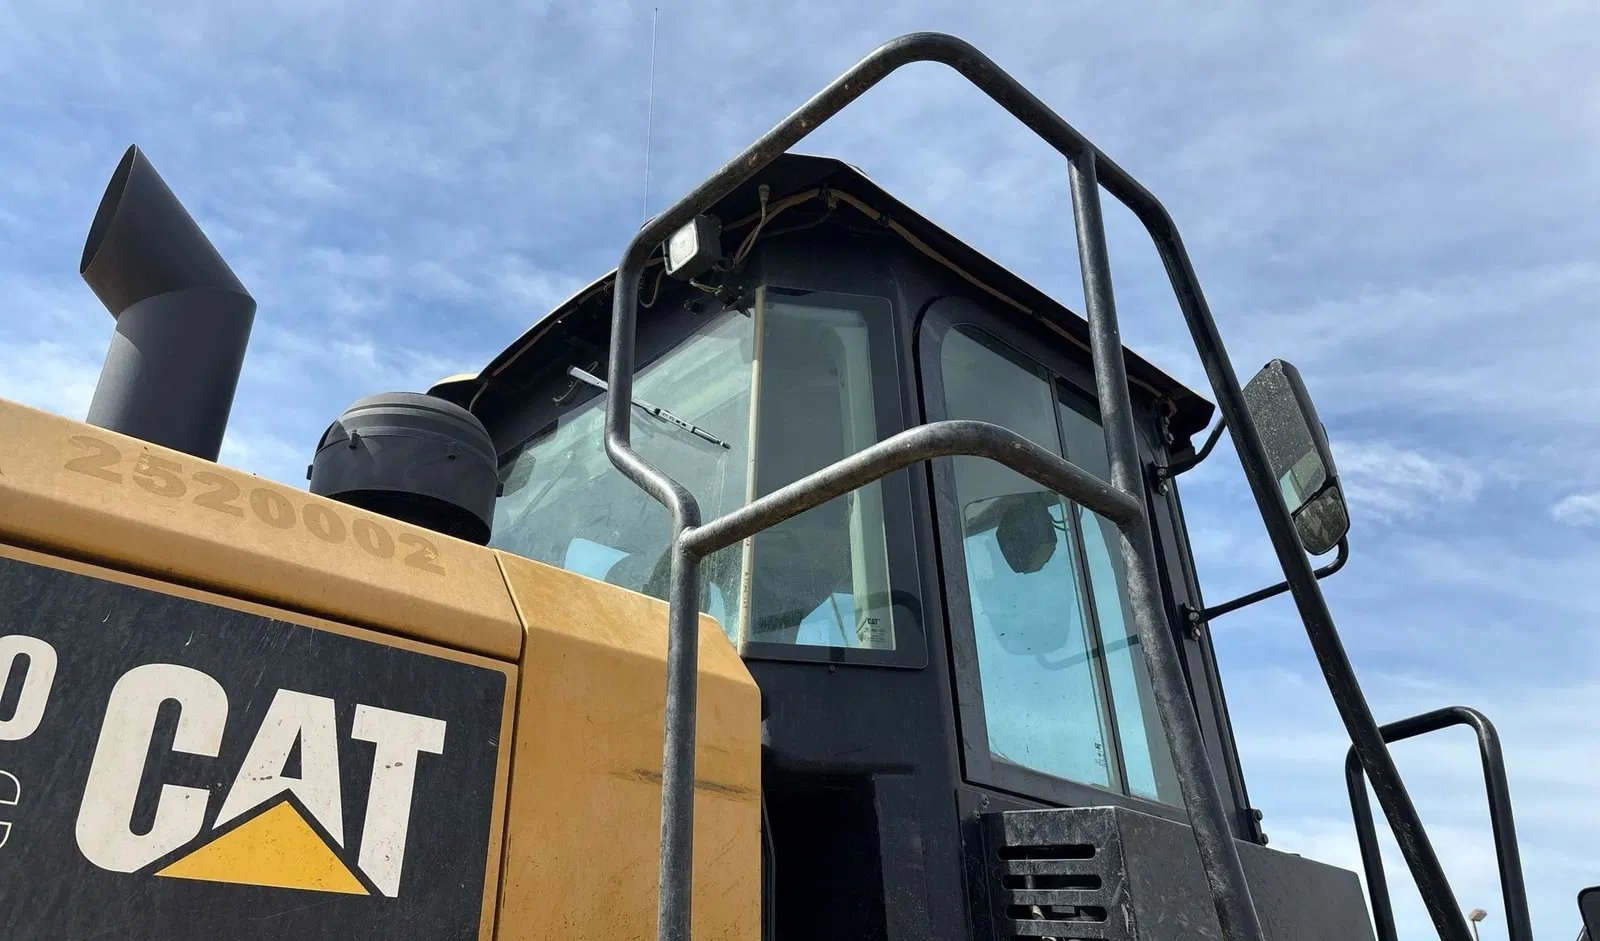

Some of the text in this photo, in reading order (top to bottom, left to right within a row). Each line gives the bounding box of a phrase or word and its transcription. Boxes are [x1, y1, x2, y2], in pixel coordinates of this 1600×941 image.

[65, 435, 446, 576] 2520002
[867, 617, 880, 625] CAT
[75, 663, 447, 898] CAT
